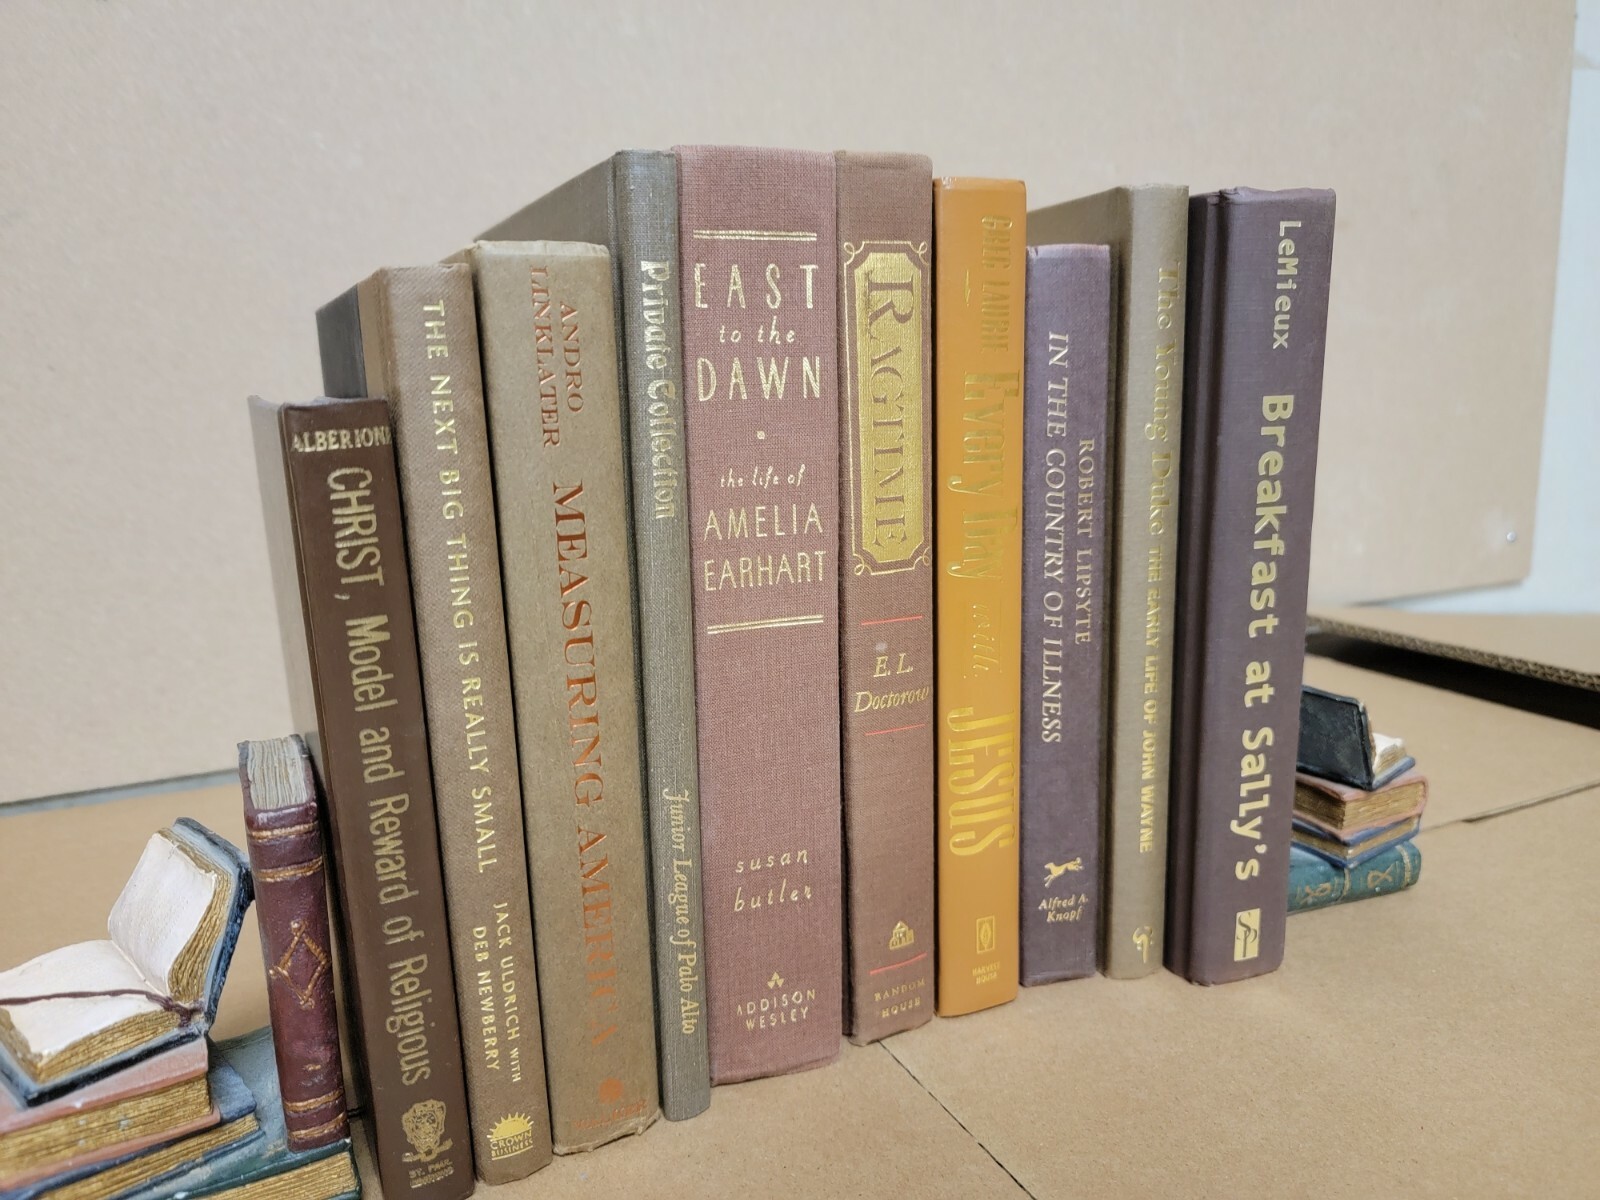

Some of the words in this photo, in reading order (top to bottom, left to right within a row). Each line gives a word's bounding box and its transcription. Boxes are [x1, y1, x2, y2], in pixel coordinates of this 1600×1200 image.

[693, 262, 819, 310] EAST
[1156, 260, 1181, 330] The
[1272, 220, 1302, 350] LeMieux
[422, 299, 449, 360] THE
[640, 260, 672, 371] Private
[719, 325, 742, 343] to
[757, 315, 796, 345] the
[530, 264, 561, 448] LINKLATER
[560, 300, 584, 413] ANDRO
[696, 355, 821, 402] DAWN
[1048, 331, 1069, 368] IN
[430, 374, 459, 455] NEXT
[1046, 377, 1069, 438] THE
[1144, 339, 1178, 442] Young
[647, 379, 680, 520] Collection
[720, 468, 744, 488] the
[752, 465, 779, 489] life
[787, 463, 806, 487] of
[438, 469, 464, 520] BIG
[1043, 447, 1066, 584] COUNTRY
[1077, 438, 1095, 538] ROBERT
[1150, 450, 1172, 536] Duke
[1247, 394, 1295, 640] Breakfast
[326, 466, 385, 600] CHRIST,
[703, 502, 823, 541] AMELIA
[446, 532, 474, 630] THING
[703, 550, 827, 592] EARHART
[1147, 546, 1163, 583] THE
[1043, 590, 1064, 629] OF
[1074, 548, 1093, 645] LIPSYTE
[1145, 587, 1162, 650] EARLY
[345, 613, 398, 712] Model
[458, 641, 479, 666] IS
[552, 478, 604, 808] MEASURING
[873, 655, 891, 678] E.
[896, 652, 914, 675] L.
[853, 685, 930, 713] Doctorow
[1041, 637, 1063, 743] ILLNESS
[1143, 655, 1159, 695] LIFE
[1242, 660, 1276, 709] at
[461, 676, 490, 774] REALLY
[1143, 699, 1157, 724] OF
[359, 725, 406, 784] and
[946, 705, 1016, 857] JESUS
[1141, 729, 1157, 780] JOHN
[471, 785, 498, 874] SMALL
[662, 787, 690, 853] Junior
[1139, 785, 1155, 854] WAYNE
[1230, 726, 1273, 881] Sally's
[367, 793, 420, 905] Reward
[735, 849, 809, 873] susan
[668, 858, 693, 928] League
[733, 878, 813, 913] butler
[1038, 893, 1076, 911] Alfred
[1078, 893, 1089, 905] A.
[1046, 906, 1084, 922] Knopf
[382, 915, 426, 945] of
[472, 926, 490, 963] DEB
[493, 902, 513, 950] JACK
[669, 928, 697, 949] of
[499, 955, 521, 1041] ULDRICH
[677, 952, 699, 994] Palo
[873, 976, 926, 1002] RANDOM
[385, 953, 436, 1086] Religious
[477, 970, 501, 1071] NEWBERRY
[680, 997, 701, 1036] Alto
[745, 1006, 809, 1031] WESLEY
[509, 1046, 521, 1083] WITH
[490, 1131, 533, 1150] CROWN
